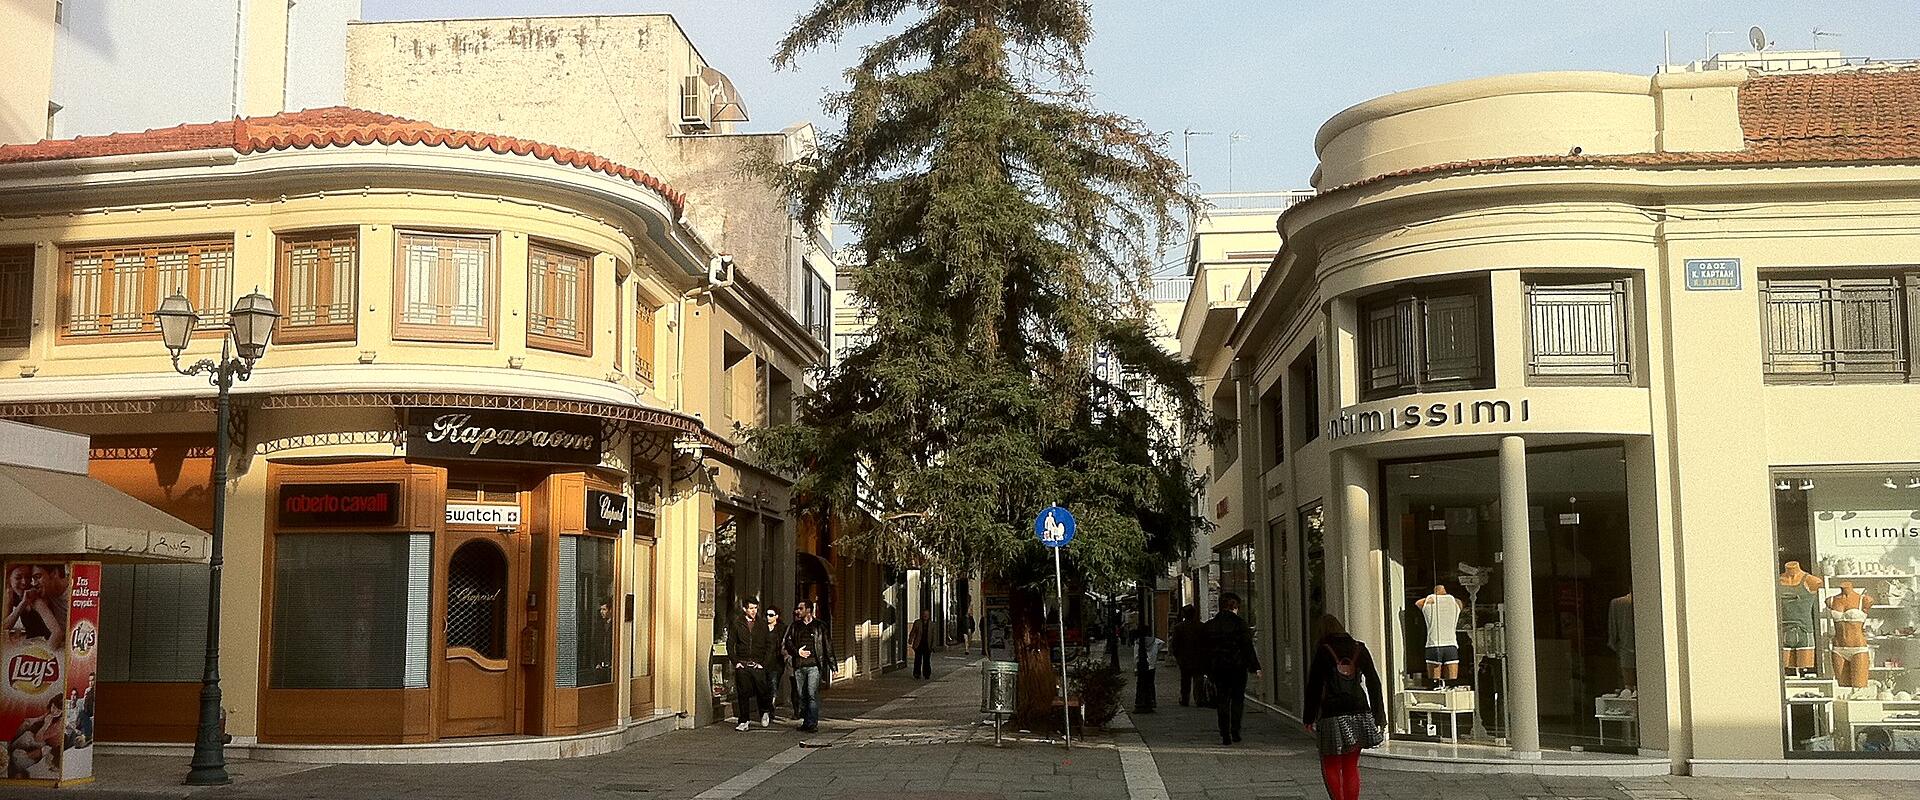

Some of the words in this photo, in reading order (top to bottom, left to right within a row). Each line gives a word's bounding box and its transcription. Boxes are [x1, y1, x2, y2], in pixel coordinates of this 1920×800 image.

[1702, 270, 1733, 278] ΚΑΡΤΑΛΗ
[1327, 399, 1529, 440] intimissimi
[287, 494, 338, 512] roberto
[341, 492, 387, 512] cavalli
[446, 509, 501, 521] swatch
[1844, 526, 1919, 538] intimis
[12, 656, 57, 688] Lay's
